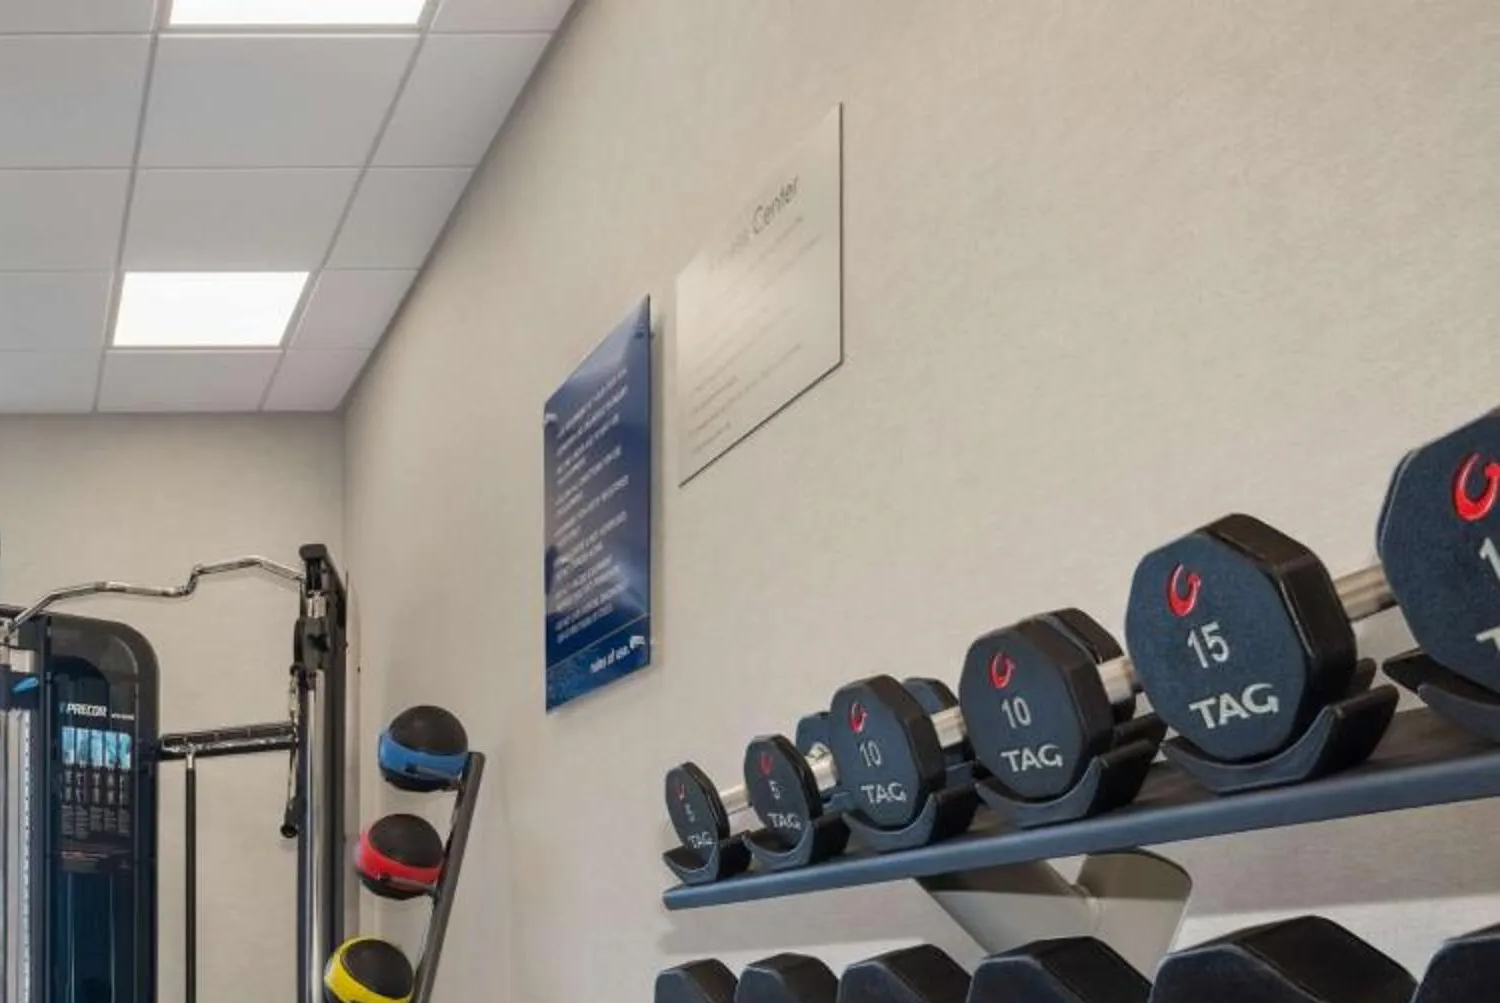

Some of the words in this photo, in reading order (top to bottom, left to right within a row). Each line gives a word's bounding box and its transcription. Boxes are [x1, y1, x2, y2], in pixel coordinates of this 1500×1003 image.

[1187, 621, 1230, 669] 15
[1001, 696, 1032, 729] 10
[1188, 682, 1279, 729] TAG
[859, 740, 882, 768] 10
[1000, 743, 1064, 772] TAG
[860, 782, 907, 804] TAG
[766, 811, 802, 830] TAG
[686, 831, 717, 849] TAG
